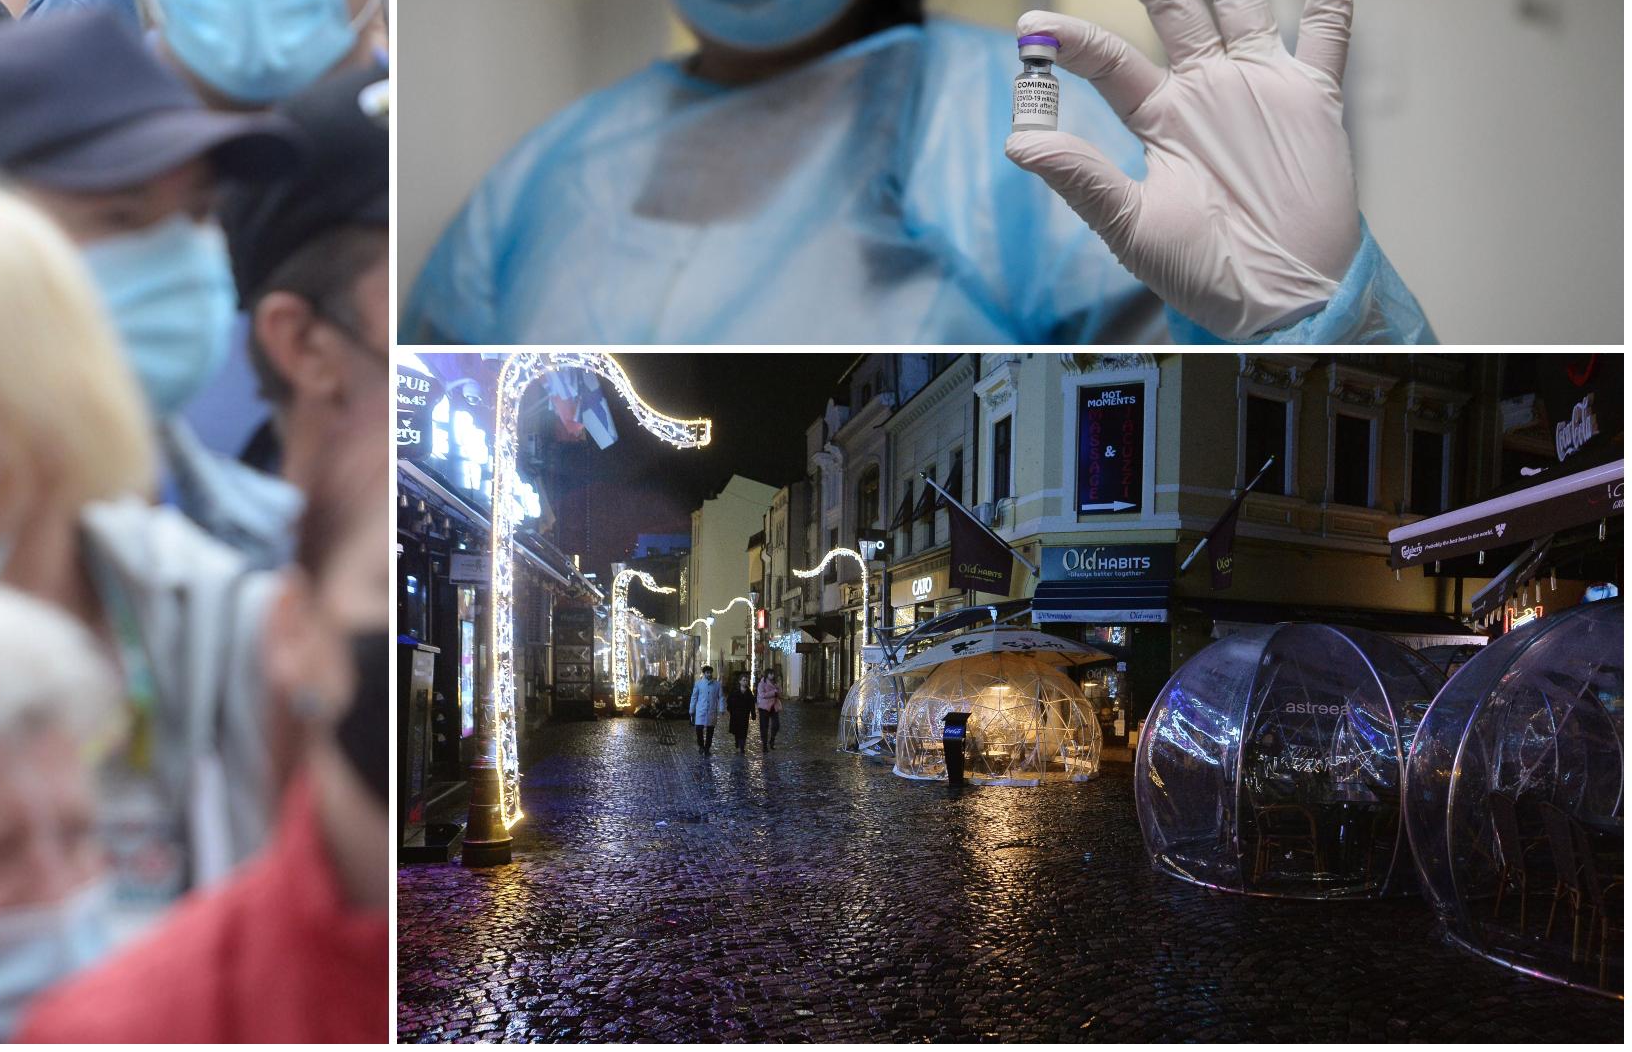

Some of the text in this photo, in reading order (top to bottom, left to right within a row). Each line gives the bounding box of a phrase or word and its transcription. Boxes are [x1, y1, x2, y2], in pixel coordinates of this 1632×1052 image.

[1088, 395, 1136, 408] MOMENTS
[1101, 391, 1121, 399] HOT
[1089, 410, 1103, 500] MASSAGE
[1104, 445, 1116, 457] &
[1062, 547, 1151, 571] Old HABITS
